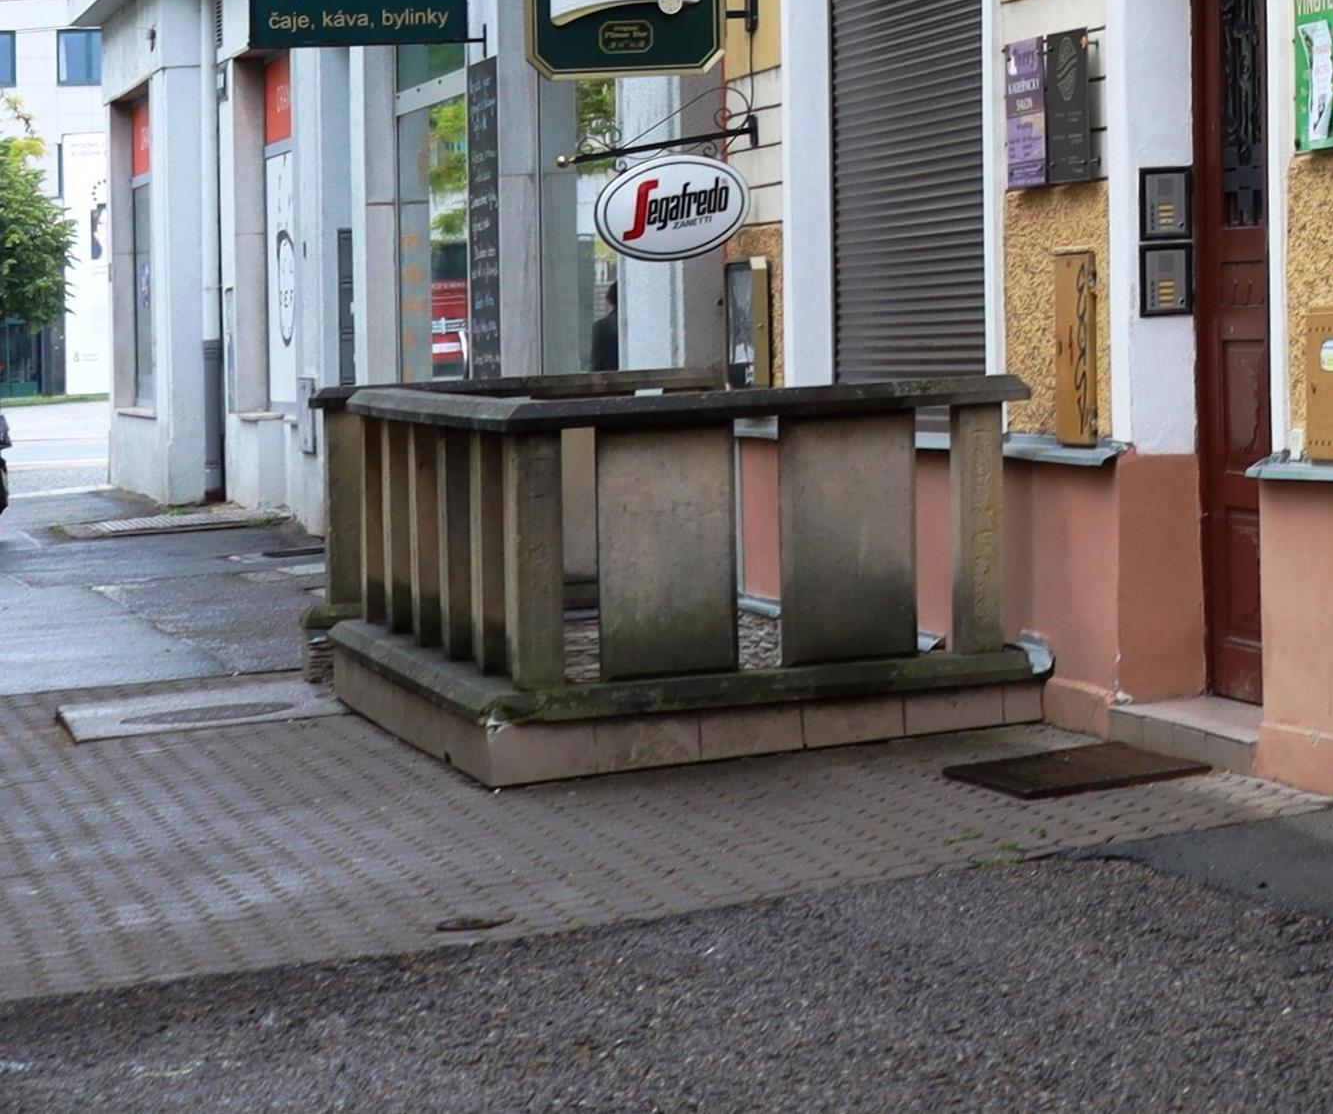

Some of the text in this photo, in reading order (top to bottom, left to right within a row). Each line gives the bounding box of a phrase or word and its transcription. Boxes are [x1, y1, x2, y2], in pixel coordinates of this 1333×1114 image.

[268, 7, 450, 34] čaje, káva, bylinky
[623, 177, 731, 241] Segafredo
[672, 216, 713, 230] ZANETTI
